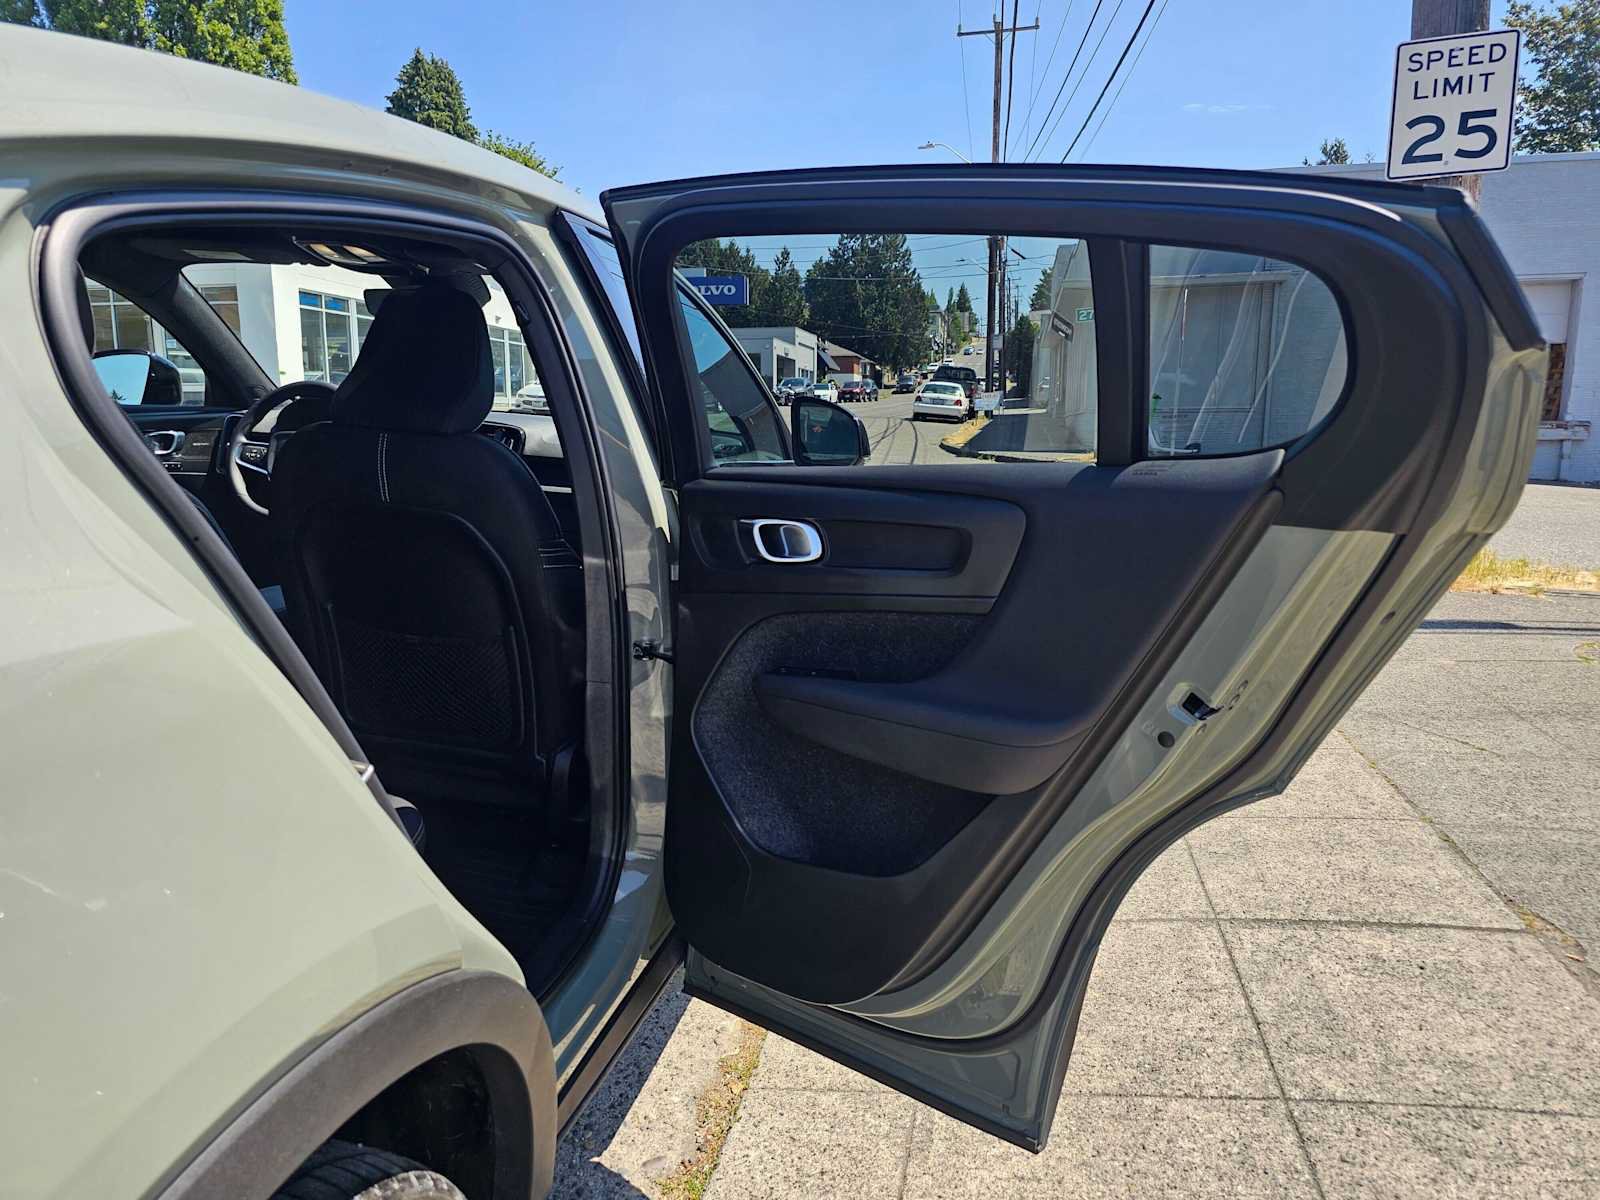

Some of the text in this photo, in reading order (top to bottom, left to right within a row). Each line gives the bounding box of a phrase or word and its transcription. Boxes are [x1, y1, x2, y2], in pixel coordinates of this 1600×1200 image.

[1408, 43, 1507, 72] SPEED
[1413, 72, 1495, 100] LIMIT
[1402, 109, 1498, 164] 25
